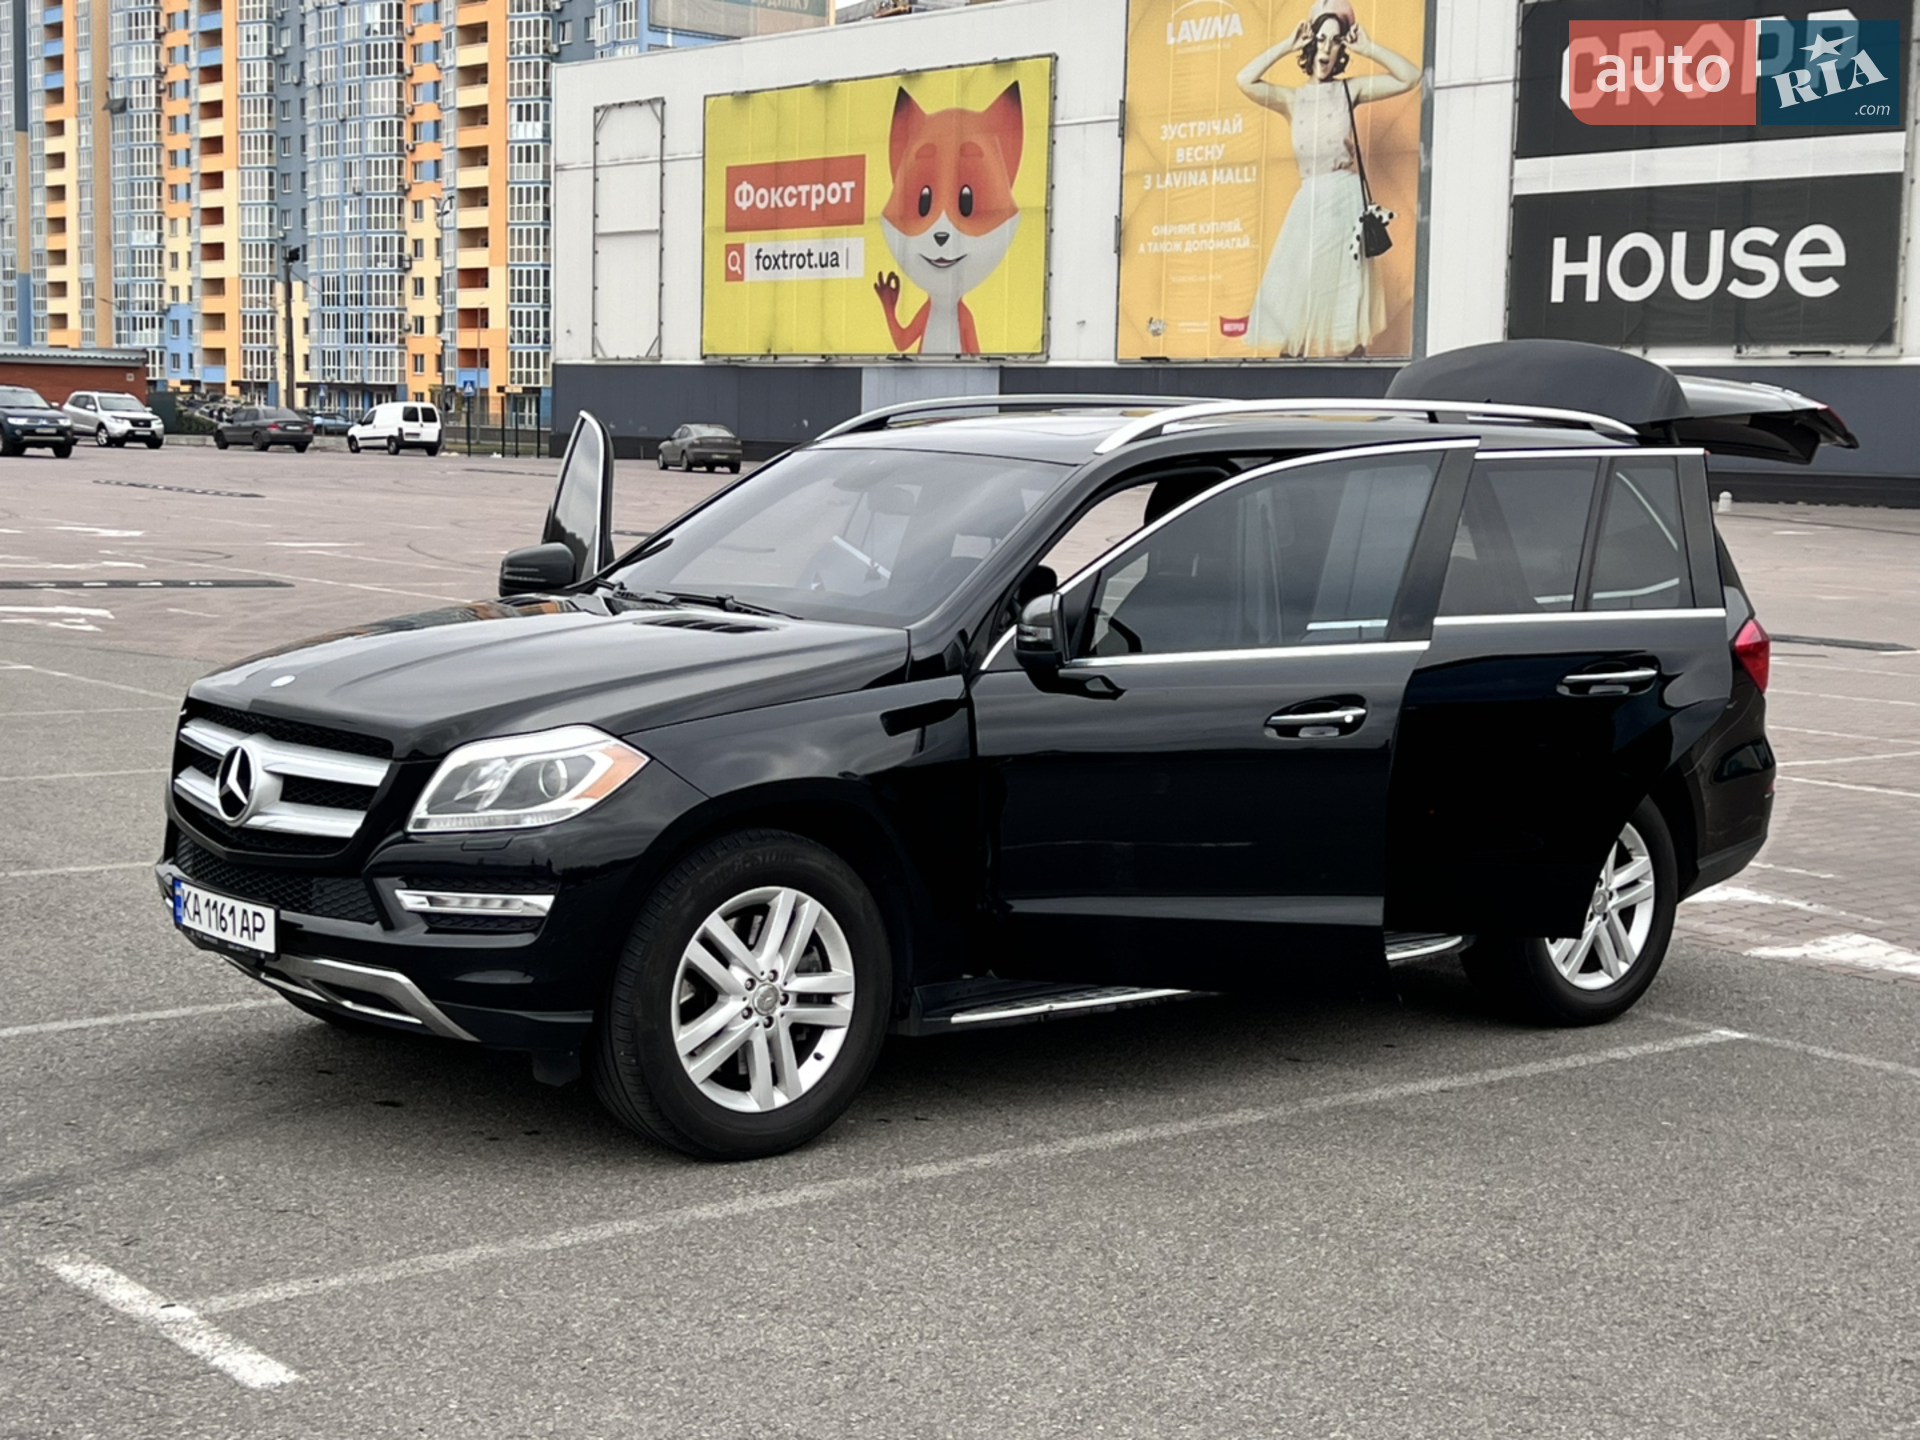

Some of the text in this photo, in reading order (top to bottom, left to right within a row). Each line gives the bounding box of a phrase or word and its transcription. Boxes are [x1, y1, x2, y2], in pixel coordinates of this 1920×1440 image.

[1166, 13, 1244, 45] LAVINA
[1160, 114, 1243, 141] ЗУСТРІЧАЙ
[1175, 144, 1226, 163] ВЕСНУ
[1156, 171, 1208, 189] LAVINA
[1212, 166, 1257, 184] MALL!
[734, 180, 856, 212] Фокстрот
[1147, 239, 1182, 254] ТАКОЖ
[755, 248, 840, 271] foxtrot.ua
